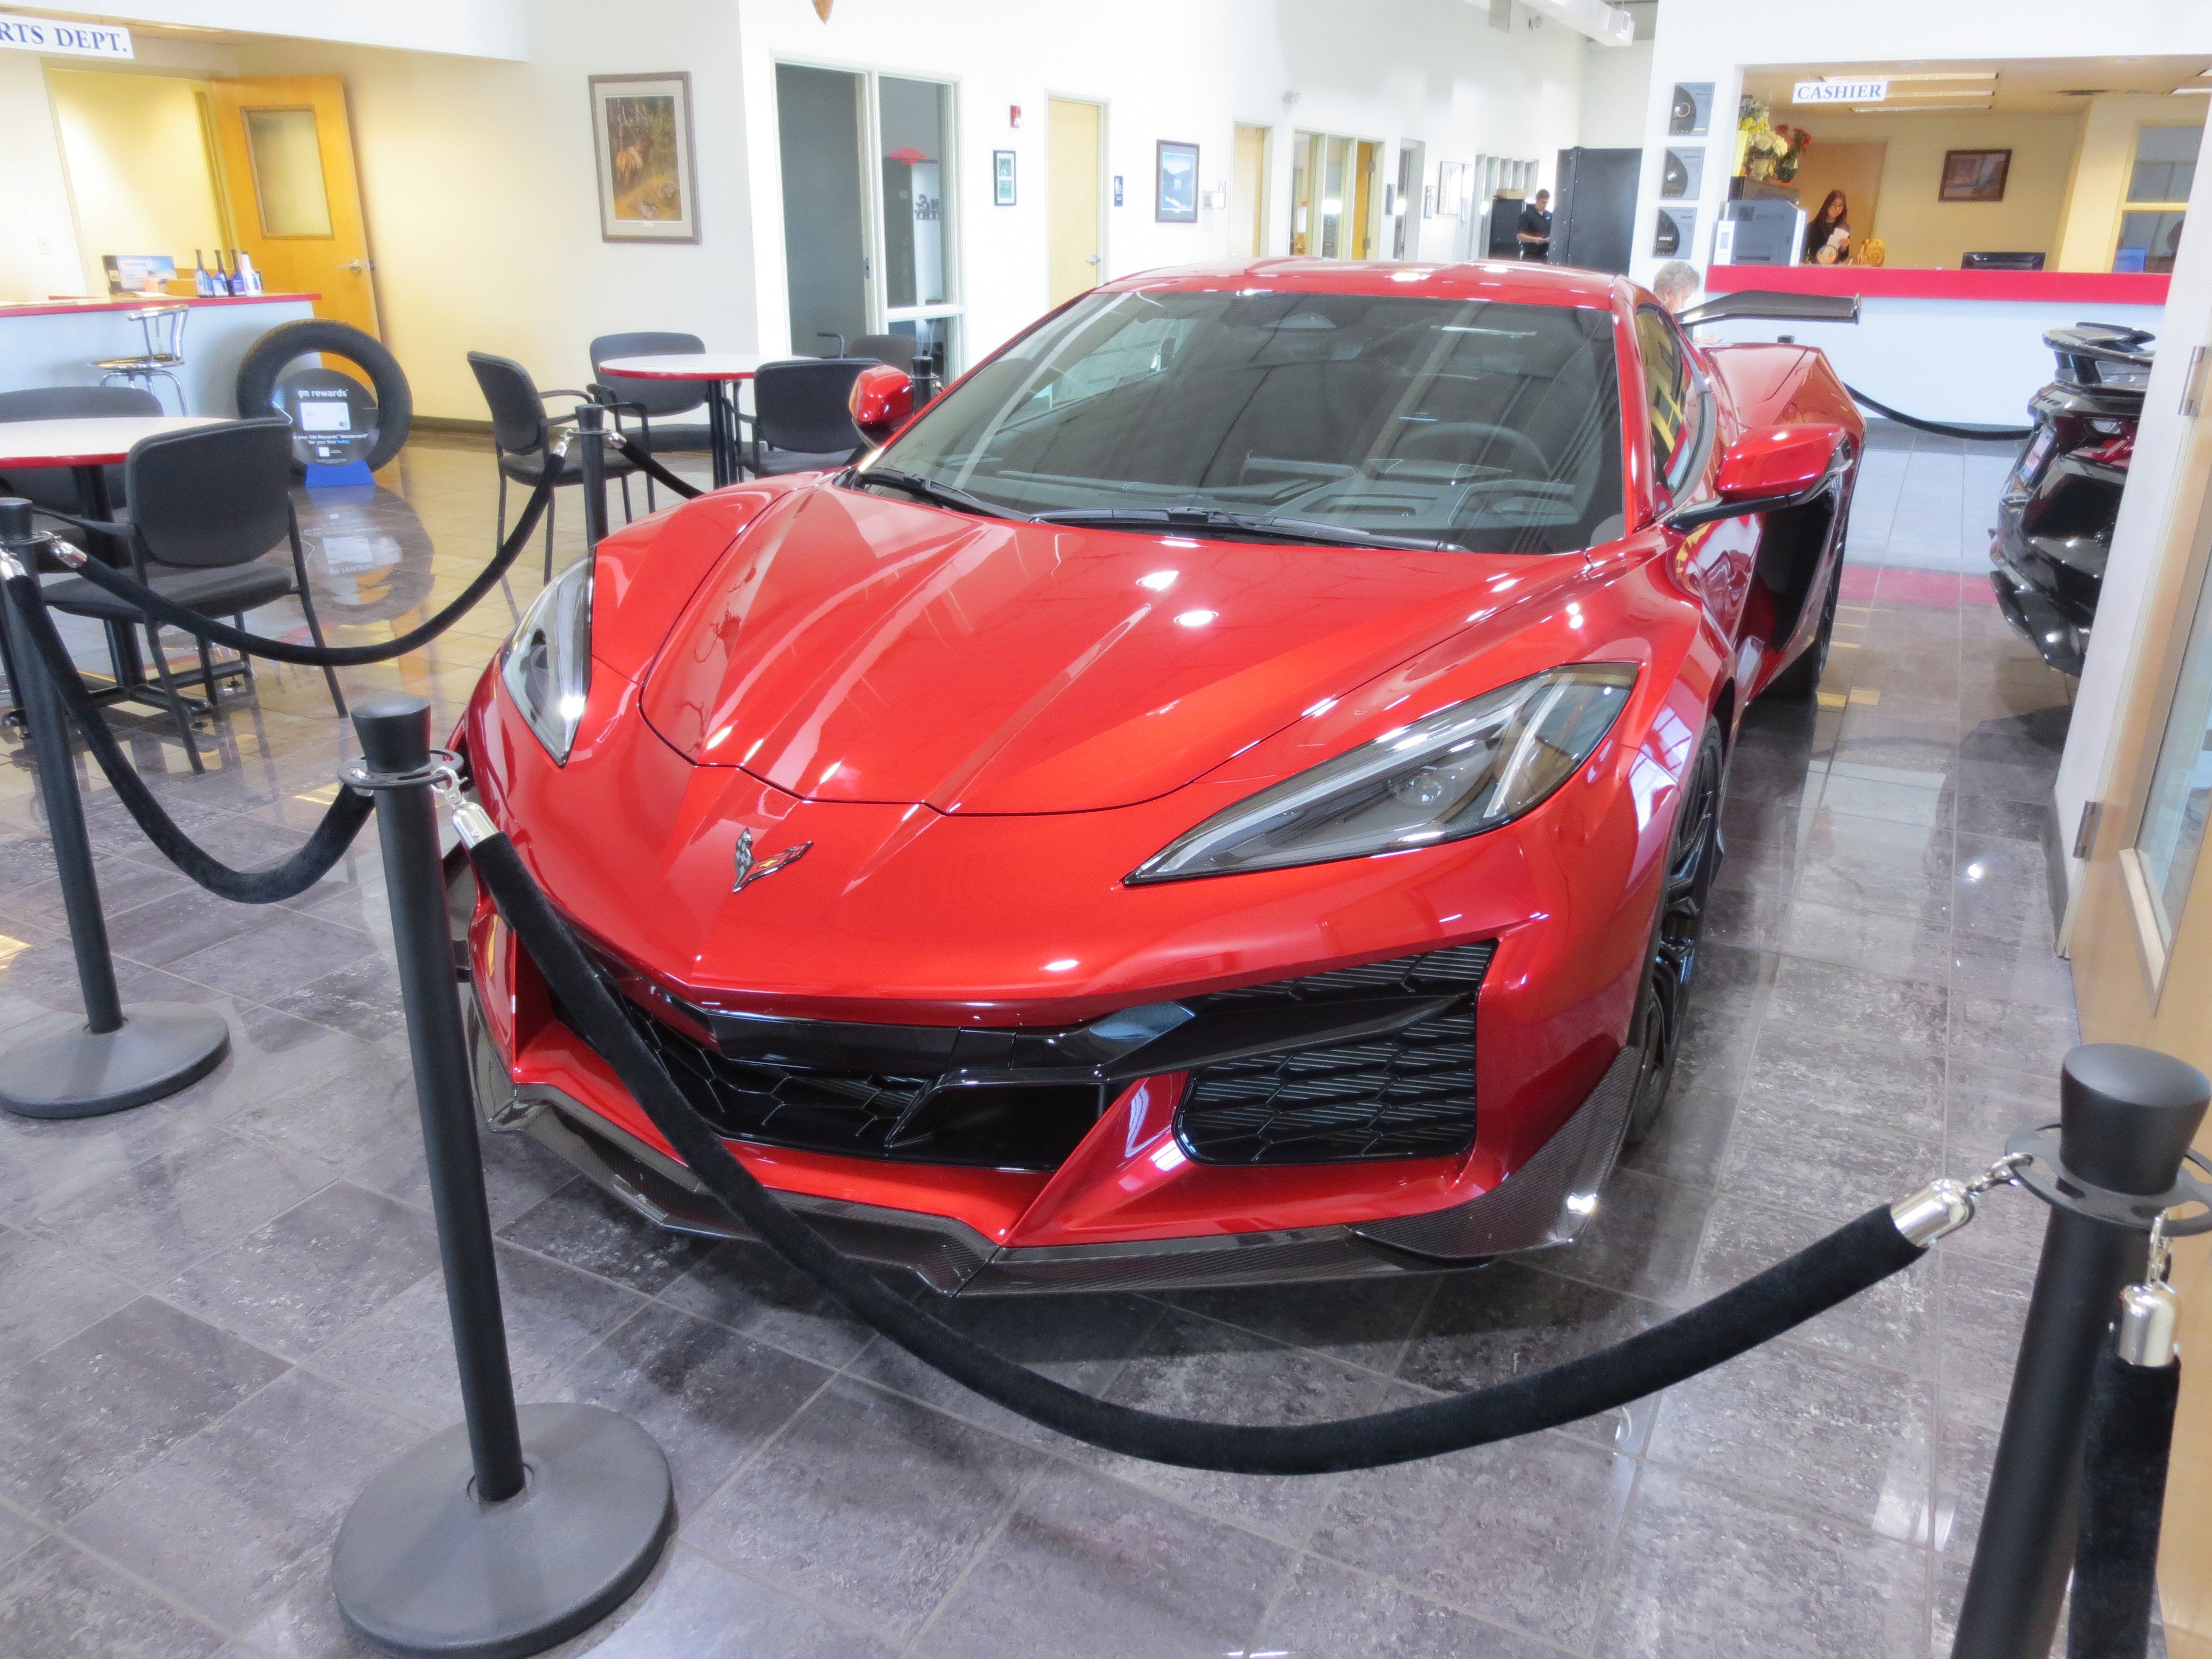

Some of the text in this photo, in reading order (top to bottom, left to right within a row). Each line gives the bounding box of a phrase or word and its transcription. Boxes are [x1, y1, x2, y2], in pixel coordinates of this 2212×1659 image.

[53, 27, 128, 52] DEPT.
[1797, 84, 1882, 99] CASHIER
[298, 389, 348, 399] gm rewards
